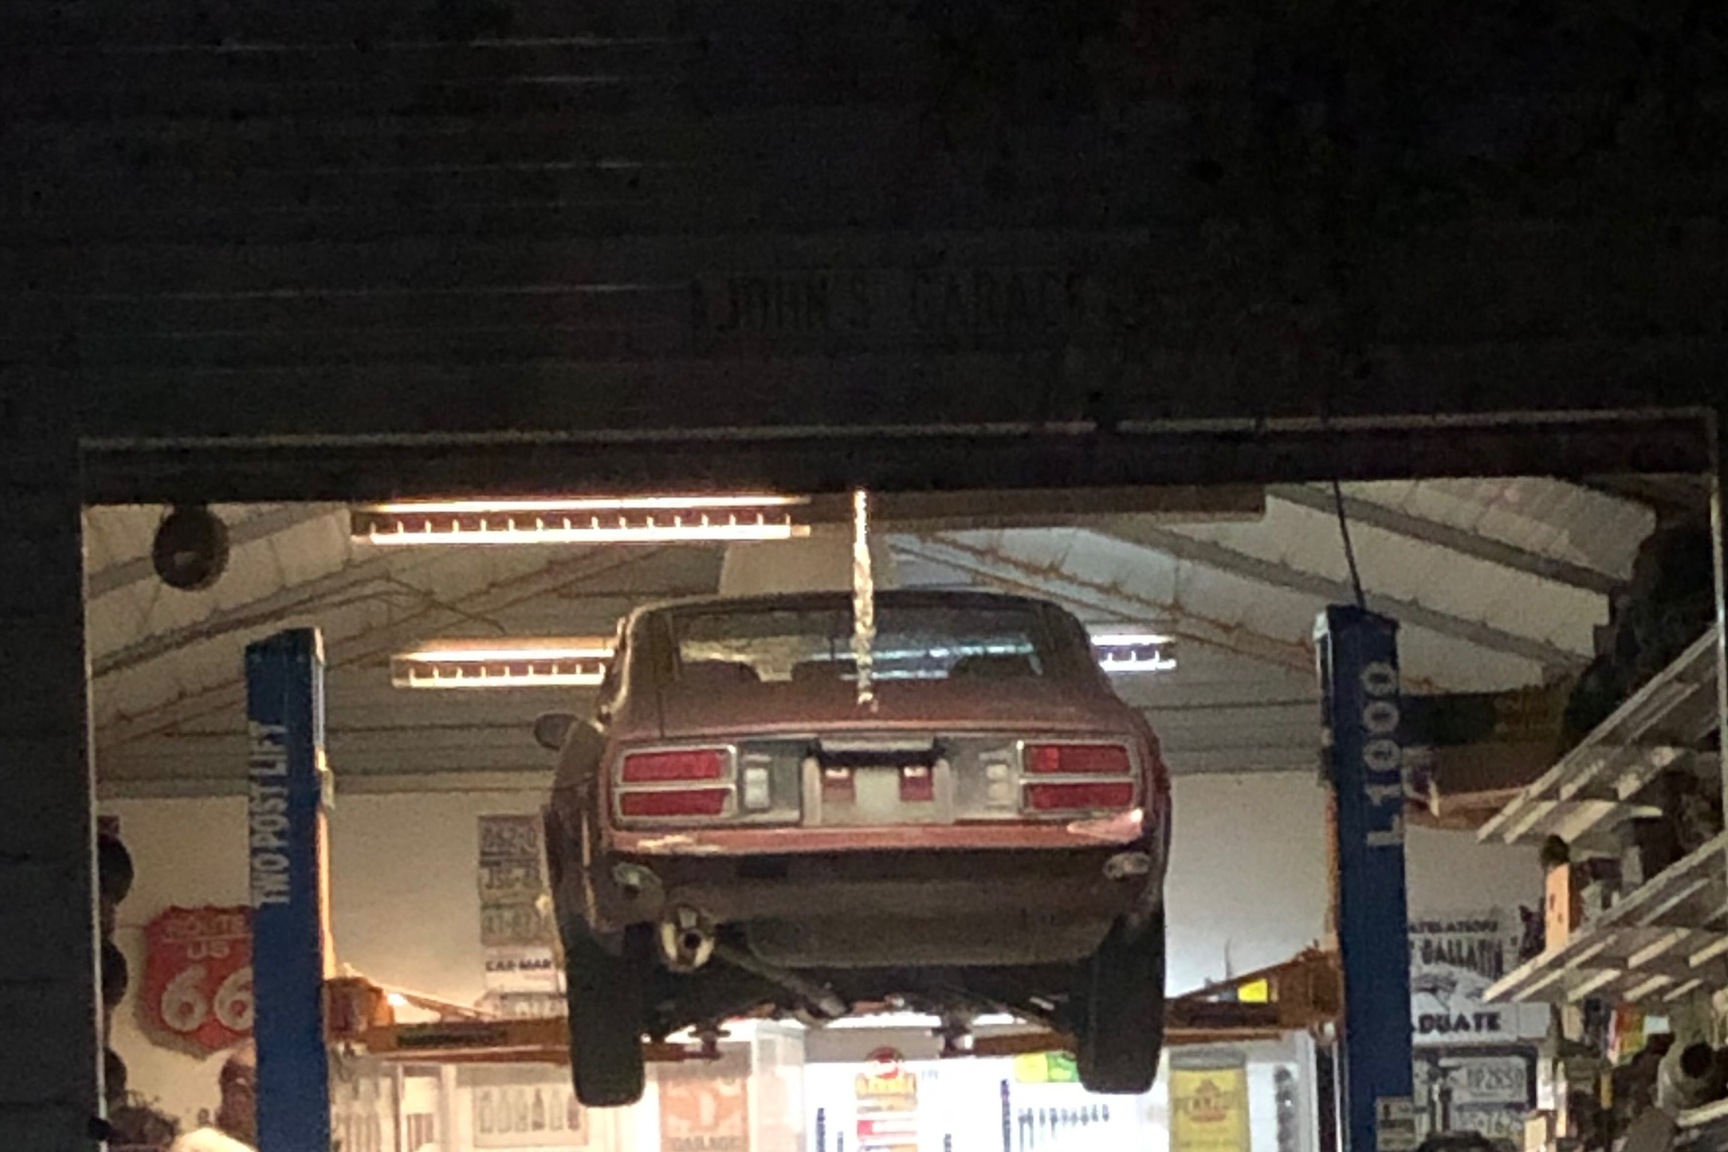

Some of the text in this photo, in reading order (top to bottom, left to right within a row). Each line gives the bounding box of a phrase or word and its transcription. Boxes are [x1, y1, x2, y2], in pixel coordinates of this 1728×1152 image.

[251, 720, 291, 905] TWO POST LIFT
[186, 941, 231, 960] US
[161, 965, 254, 1032] 66
[1411, 1011, 1501, 1034] DUATE
